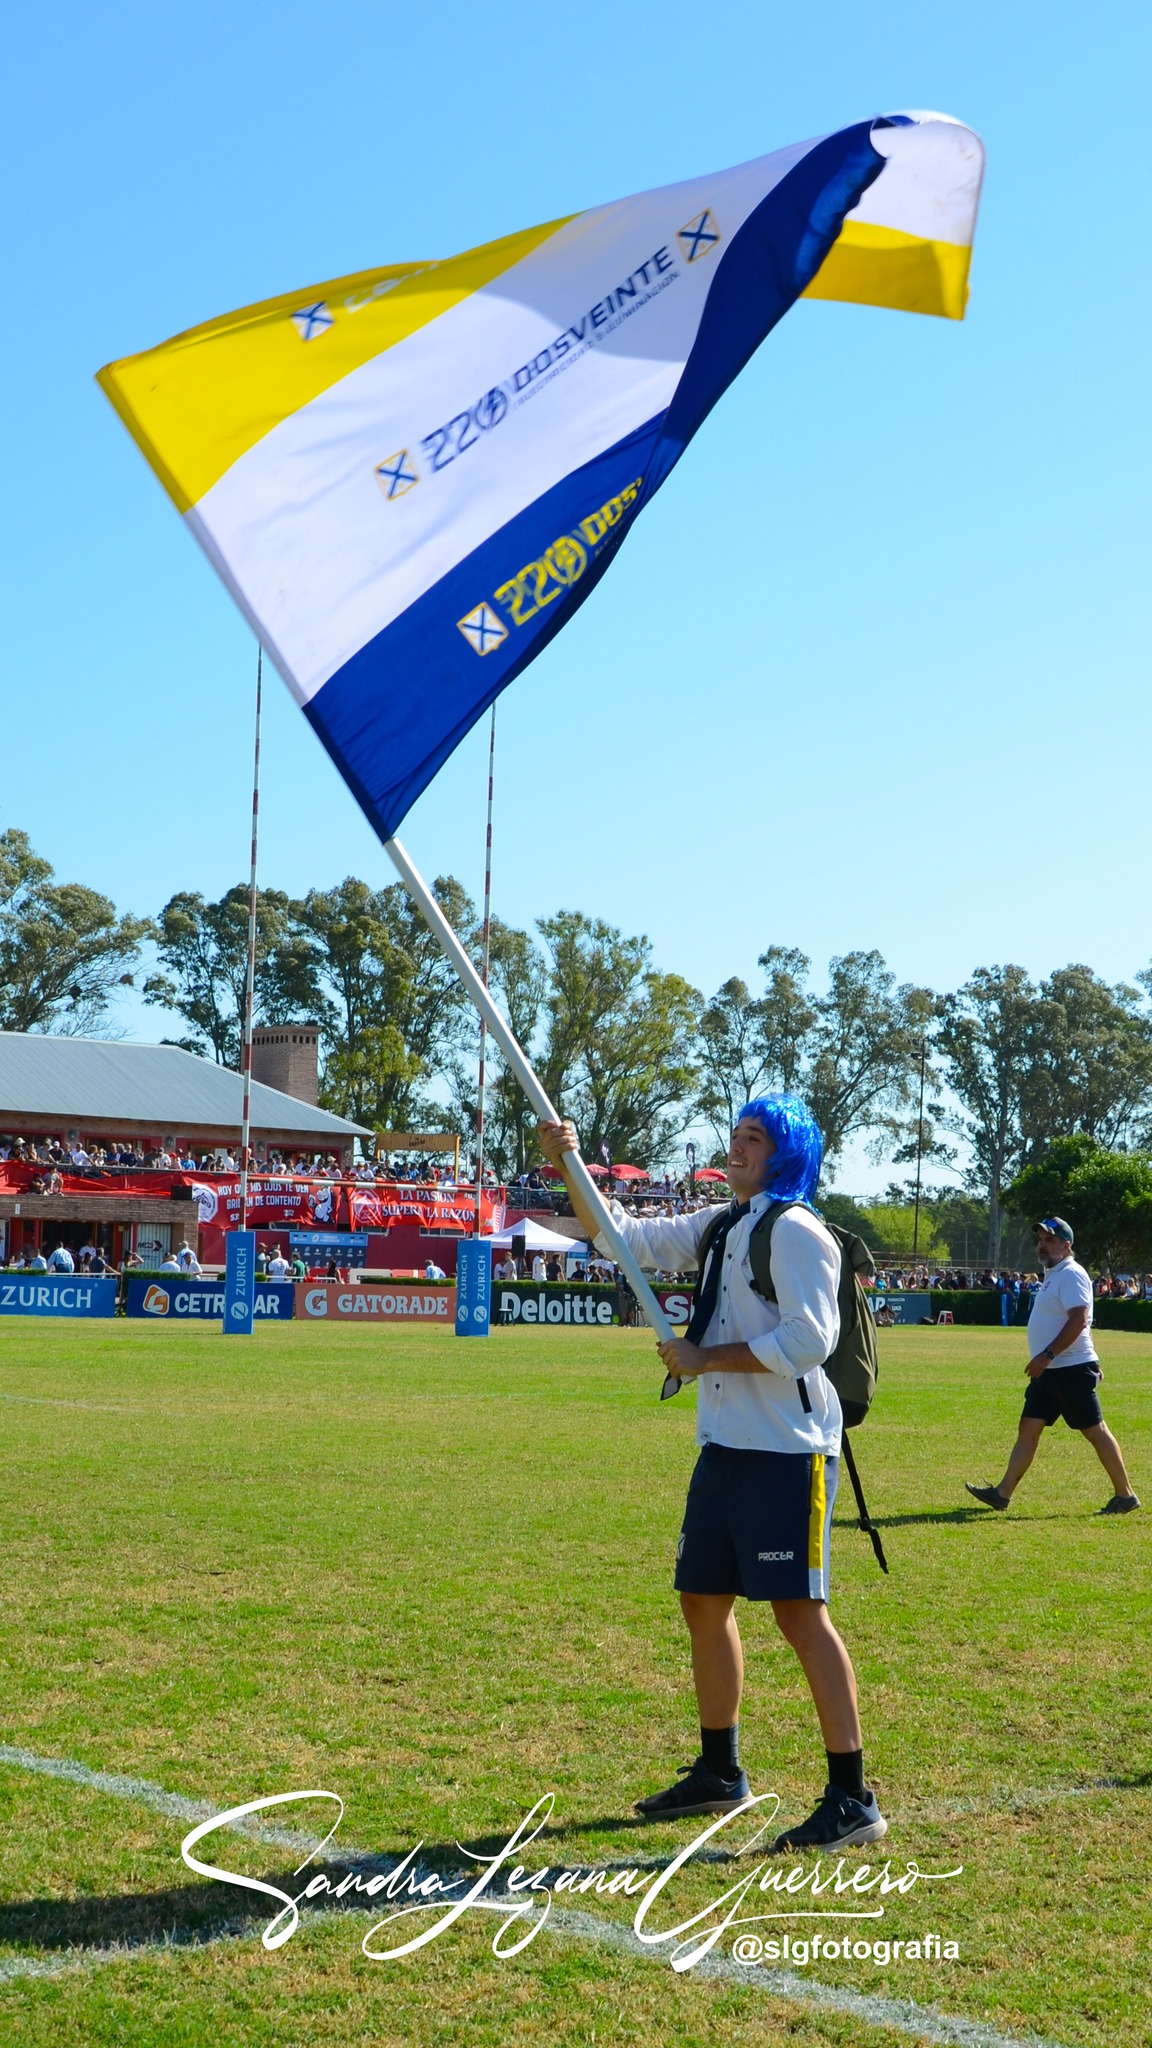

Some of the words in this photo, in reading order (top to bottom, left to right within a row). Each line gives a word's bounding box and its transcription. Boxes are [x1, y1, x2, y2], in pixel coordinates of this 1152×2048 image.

[512, 245, 675, 393] DOSVEINTE
[217, 1185, 232, 1196] HOY
[255, 1196, 264, 1207] DE
[266, 1195, 301, 1207] CONTENTO
[400, 1189, 413, 1201] LA
[382, 1203, 424, 1218] SUPERA
[427, 1206, 438, 1218] LA
[236, 1247, 247, 1296] ZURICH
[460, 1254, 468, 1300] ZURICH
[477, 1255, 486, 1301] ZURICH
[0, 1285, 92, 1309] ZURICH
[337, 1293, 448, 1316] GATORADE
[758, 1551, 794, 1562] PROCER
